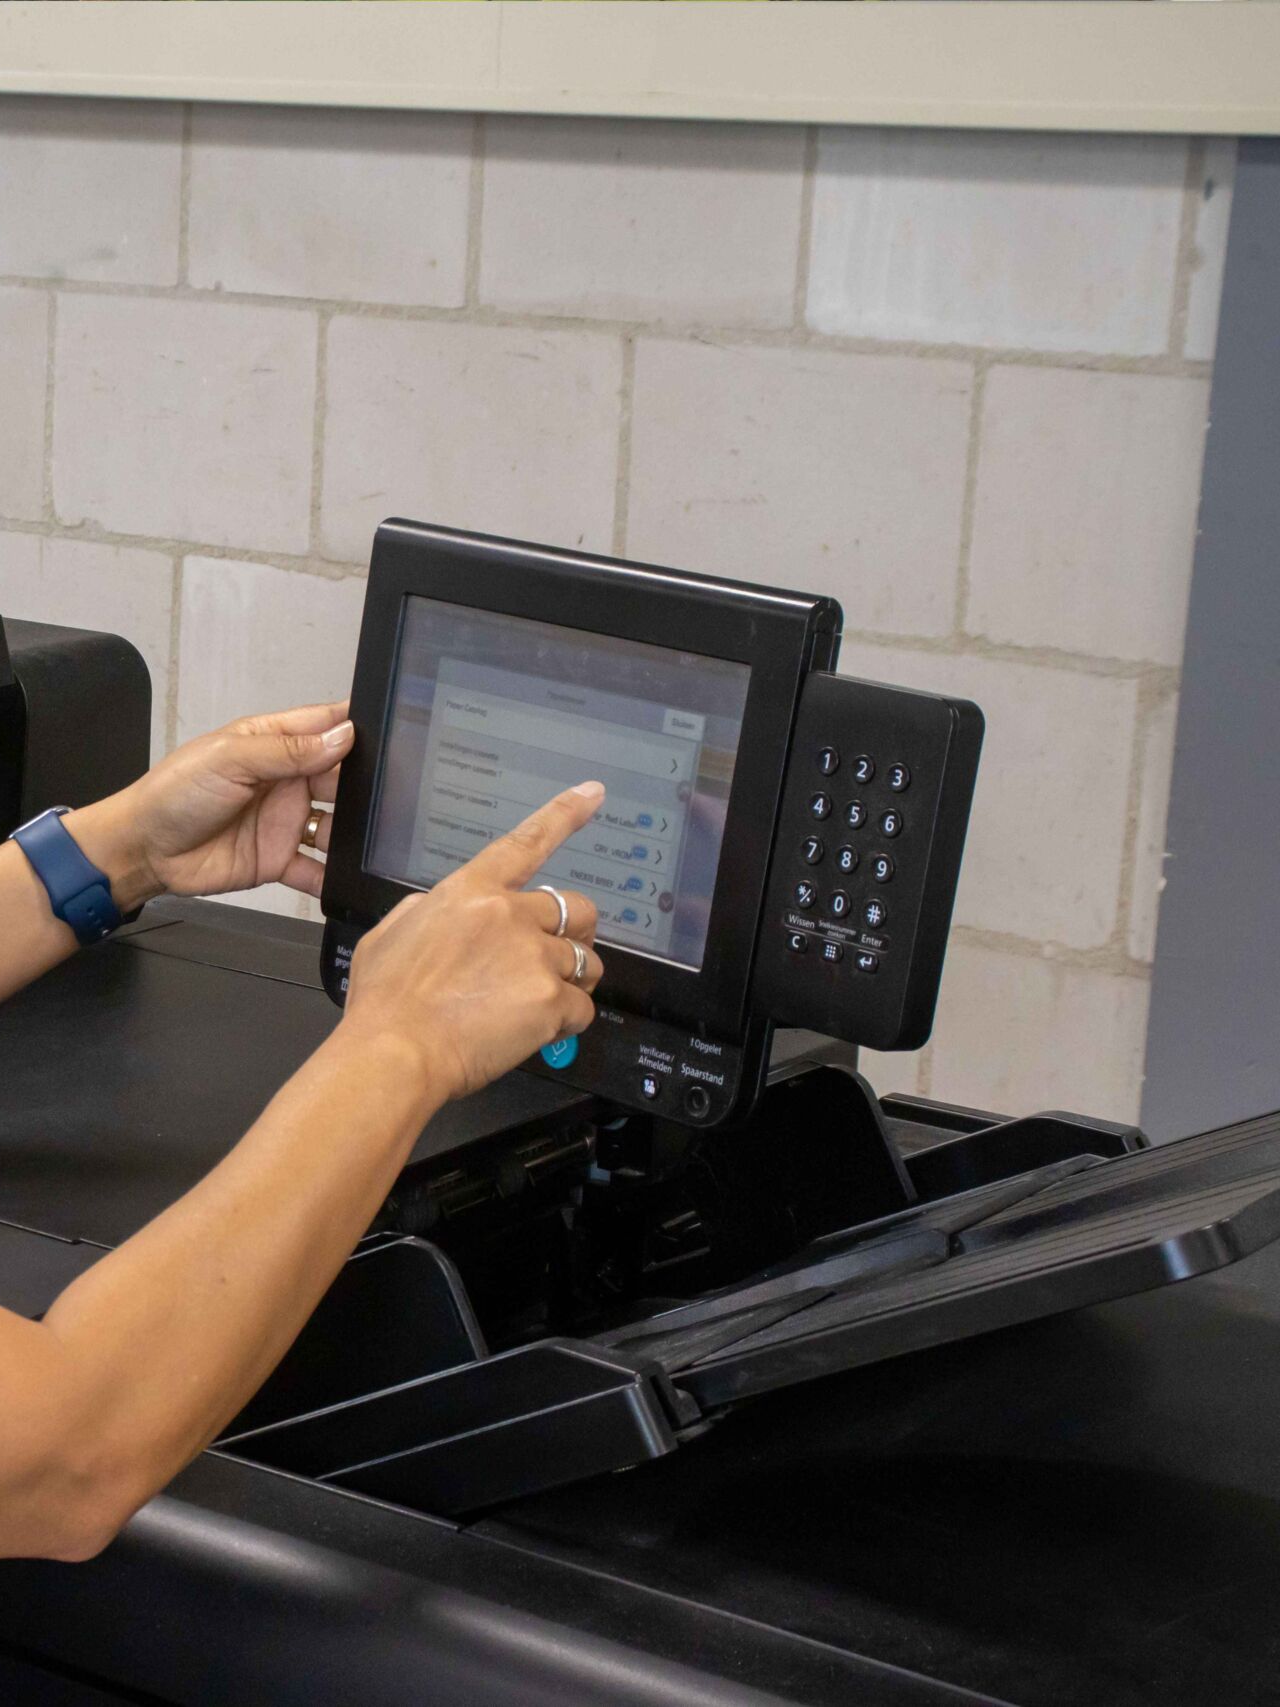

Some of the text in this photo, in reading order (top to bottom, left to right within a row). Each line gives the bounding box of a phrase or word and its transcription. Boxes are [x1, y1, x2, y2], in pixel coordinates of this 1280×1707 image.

[824, 753, 831, 769] 1
[857, 760, 868, 778] 2
[892, 769, 903, 787] 3
[813, 798, 824, 815] 4
[850, 806, 861, 824] 5
[885, 815, 895, 833] 6
[808, 842, 818, 859] 7
[841, 851, 852, 868] 8
[877, 860, 887, 878] 9
[833, 895, 844, 913] 0
[788, 914, 816, 930] Wissen
[791, 935, 800, 949] C
[861, 933, 883, 949] Enter
[694, 1038, 722, 1057] Opgelet
[638, 1055, 673, 1075] Afmelden
[681, 1063, 724, 1086] Spaarstand
